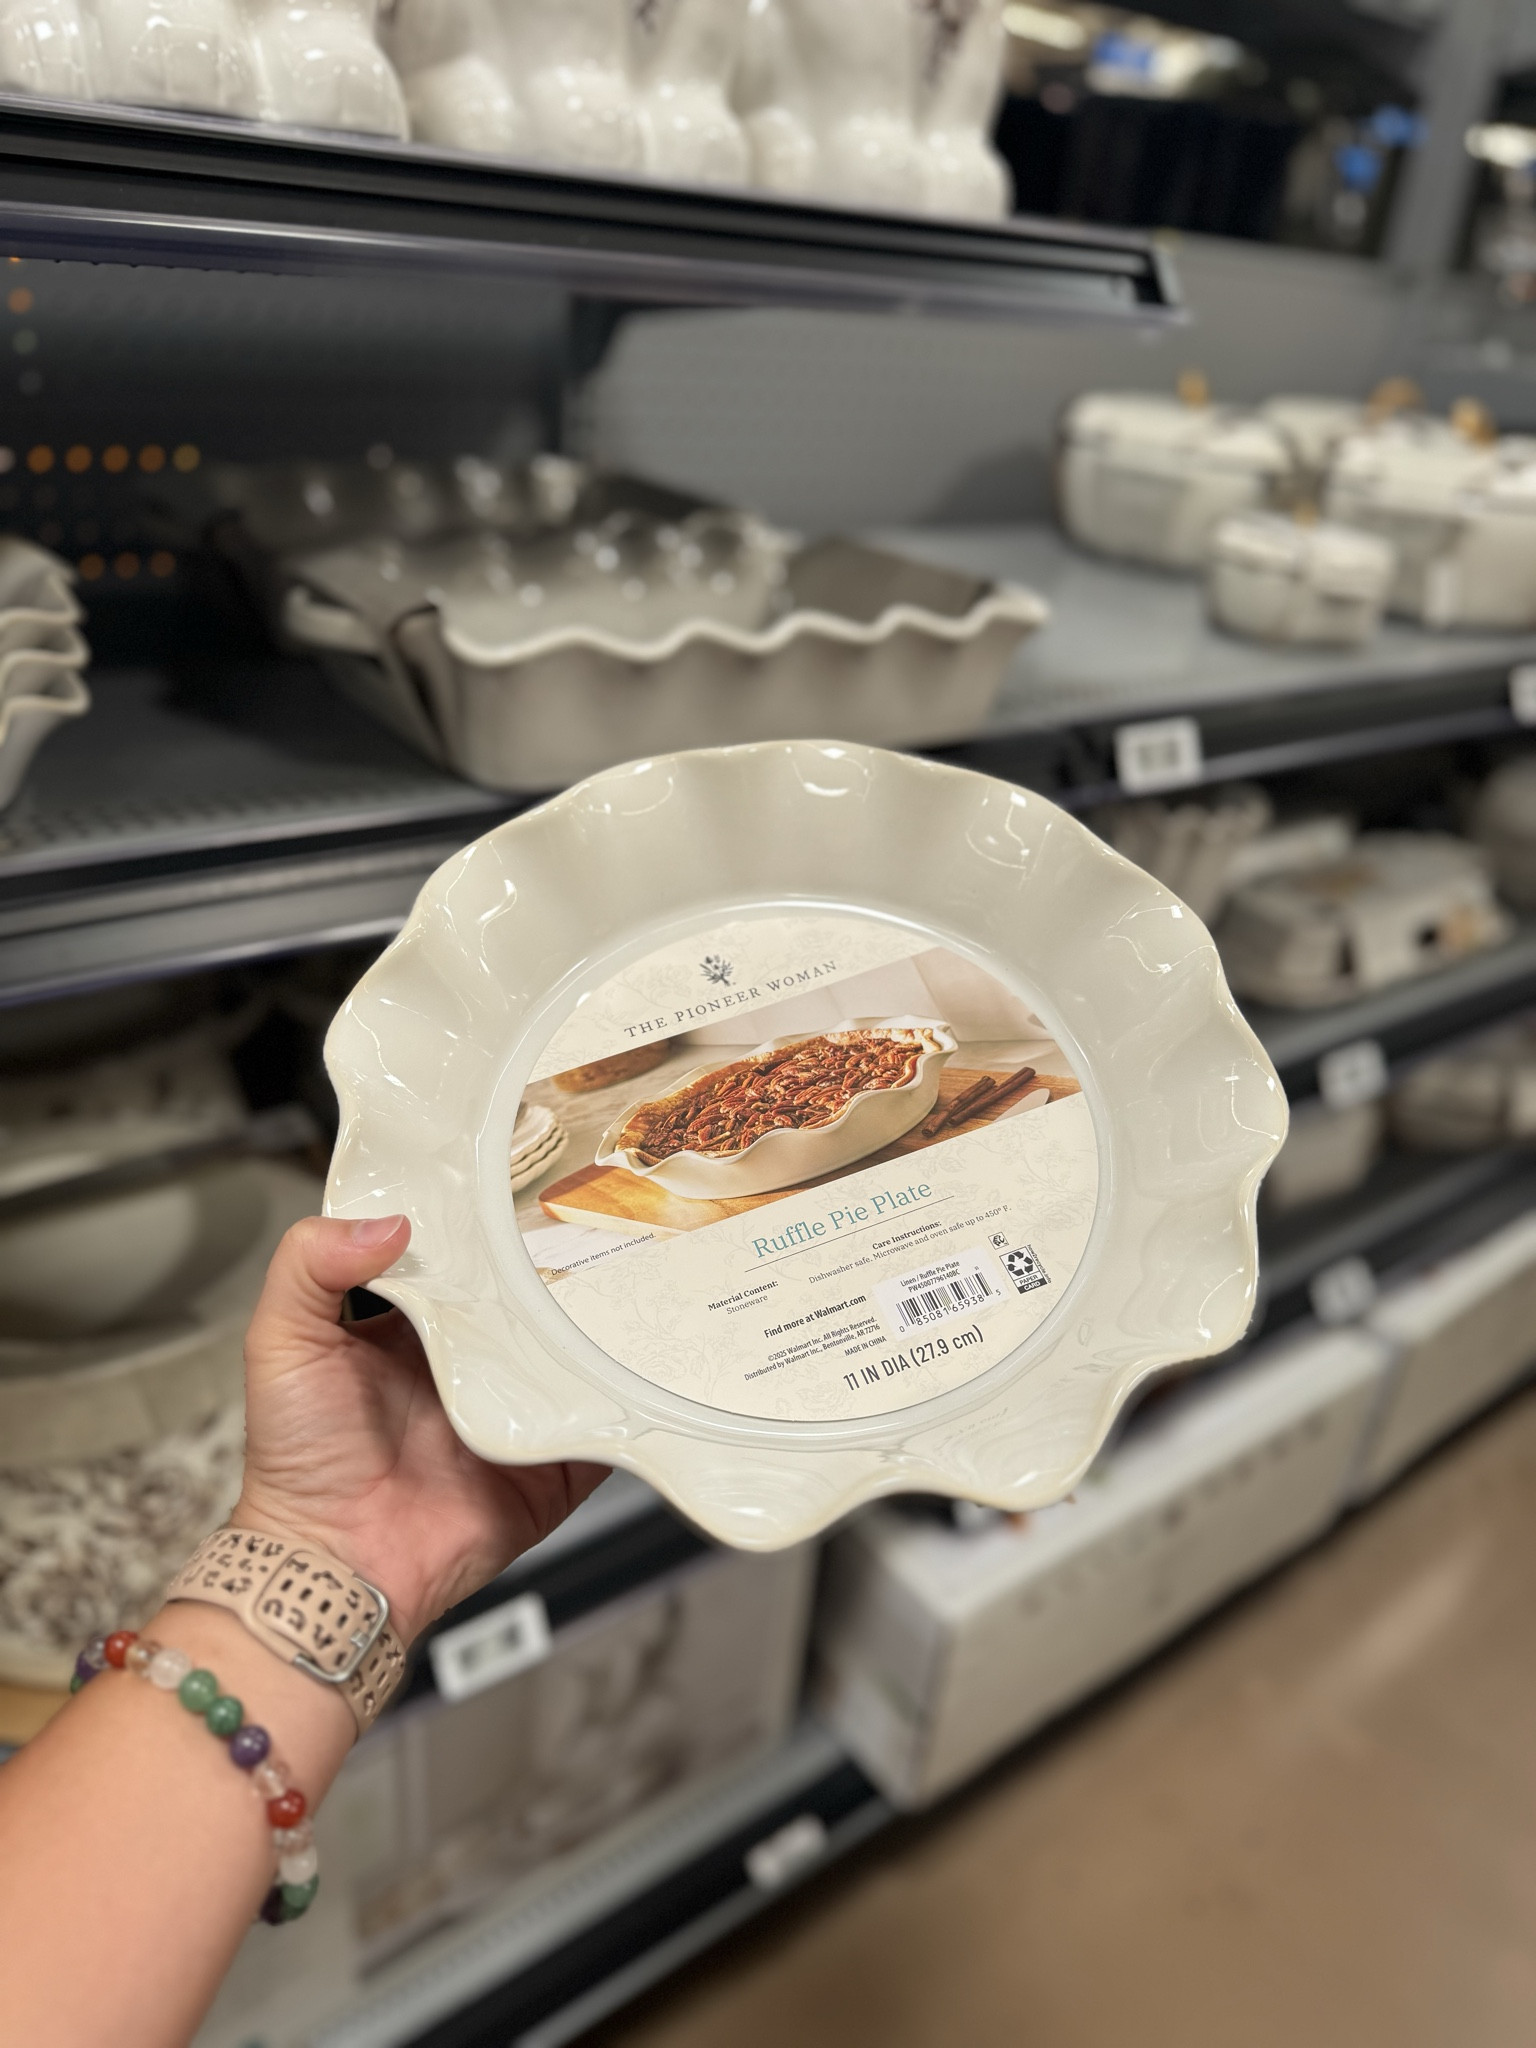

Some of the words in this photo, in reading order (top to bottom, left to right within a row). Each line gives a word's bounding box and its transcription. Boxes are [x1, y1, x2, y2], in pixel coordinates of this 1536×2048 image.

[624, 1017, 667, 1038] THE
[674, 987, 761, 1022] PIONEER
[766, 960, 838, 991] WOMAN
[751, 1221, 827, 1258] Ruffle
[828, 1206, 869, 1230] Pie
[870, 1183, 932, 1215] Plate
[872, 1239, 892, 1250] Care
[891, 1221, 942, 1243] Instructions:
[551, 1257, 590, 1276] Decorative
[590, 1250, 610, 1261] items
[610, 1245, 624, 1253] not
[624, 1232, 656, 1248] included.
[808, 1261, 854, 1284] Dishwasher
[854, 1257, 873, 1267] safe.
[872, 1240, 913, 1260] Microwave
[915, 1234, 929, 1245] and
[929, 1228, 949, 1239] oven
[948, 1221, 965, 1232] safe
[965, 1218, 976, 1227] up
[976, 1214, 985, 1222] to
[708, 1292, 744, 1311] Material
[743, 1280, 779, 1298] Content:
[900, 1277, 917, 1287] Linen
[919, 1269, 936, 1280] Ruffle
[936, 1266, 946, 1274] Pie
[945, 1261, 960, 1270] Plate
[1019, 1274, 1039, 1285] PAPER
[1024, 1281, 1041, 1291] CARD
[726, 1295, 768, 1315] Stoneware
[763, 1324, 784, 1339] Find
[783, 1318, 805, 1331] more
[805, 1313, 815, 1323] at
[814, 1295, 867, 1319] Walmart.com
[899, 1325, 905, 1333] 0
[995, 1288, 1002, 1296] 5
[744, 1364, 777, 1381] Distributed
[776, 1359, 785, 1368] by
[784, 1351, 810, 1365] Walmart
[810, 1345, 823, 1354] Inc.,
[822, 1333, 857, 1350] Bentonville,
[856, 1329, 866, 1338] AR
[865, 1323, 881, 1335] 72716
[767, 1349, 788, 1362] ©2025
[786, 1341, 813, 1355] Walmart
[811, 1336, 824, 1345] Inc.
[822, 1332, 832, 1341] All
[831, 1326, 850, 1338] Rights
[849, 1316, 877, 1331] Reserved.
[843, 1372, 860, 1391] 11
[860, 1364, 880, 1385] IN
[881, 1354, 911, 1377] DIA
[909, 1338, 950, 1367] (27.9
[952, 1324, 984, 1350] cm)
[844, 1345, 861, 1357] MADE
[860, 1342, 869, 1351] IN
[868, 1335, 887, 1347] CHINA
